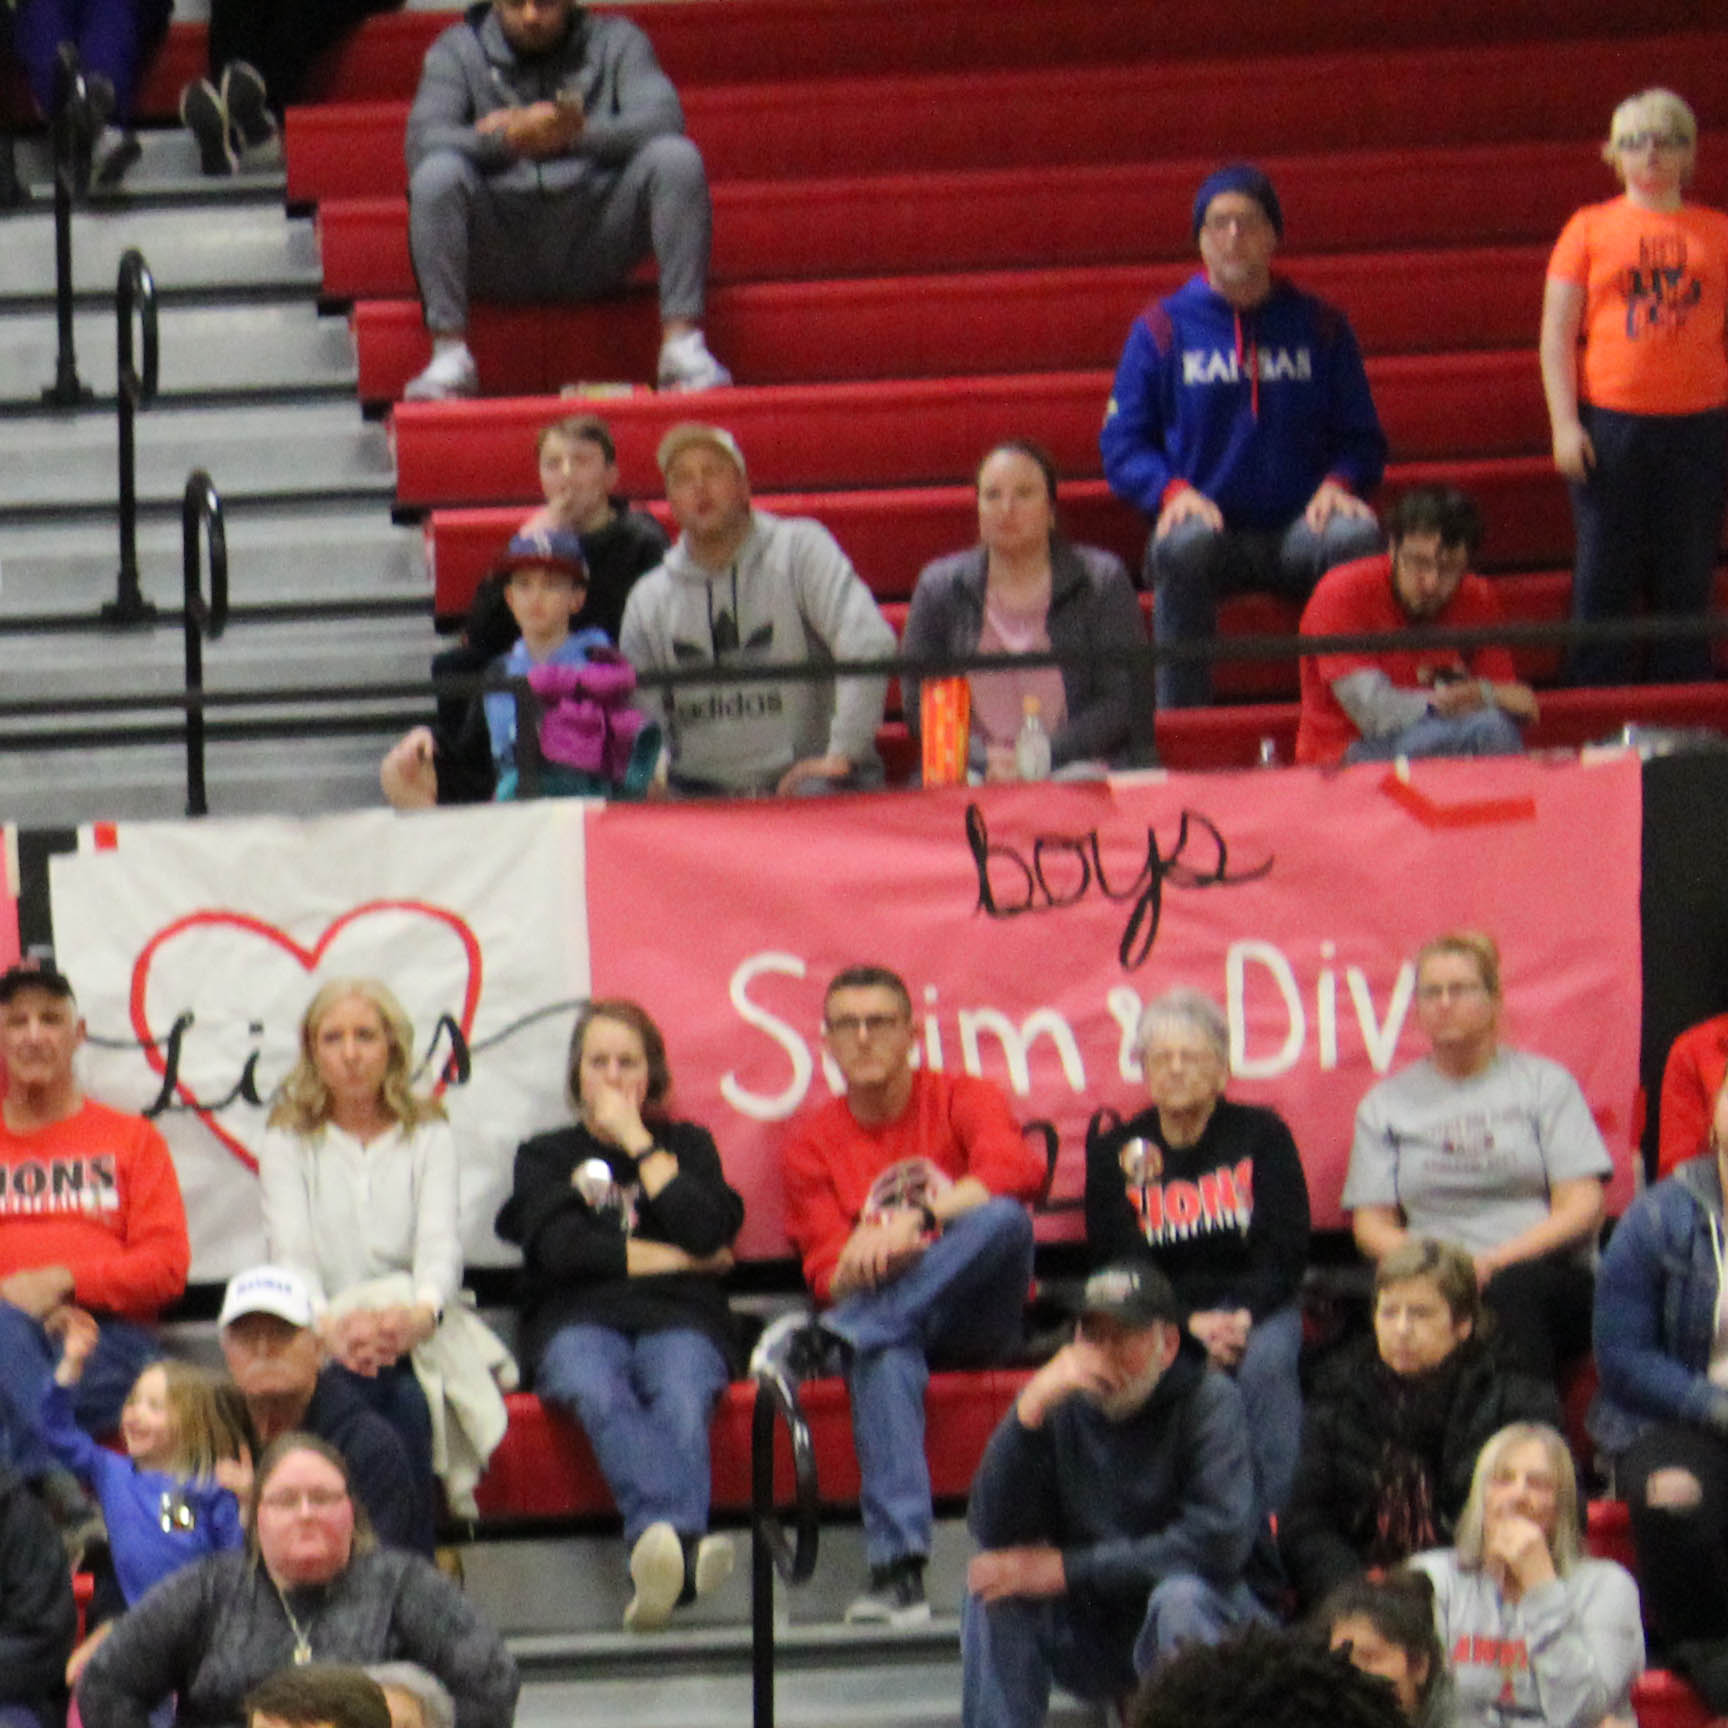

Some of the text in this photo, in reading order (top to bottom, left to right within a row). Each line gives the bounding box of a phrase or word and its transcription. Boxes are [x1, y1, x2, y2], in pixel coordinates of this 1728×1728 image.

[964, 804, 1276, 970] boys
[720, 950, 1086, 1122] Sim
[1226, 938, 1418, 1080] Div
